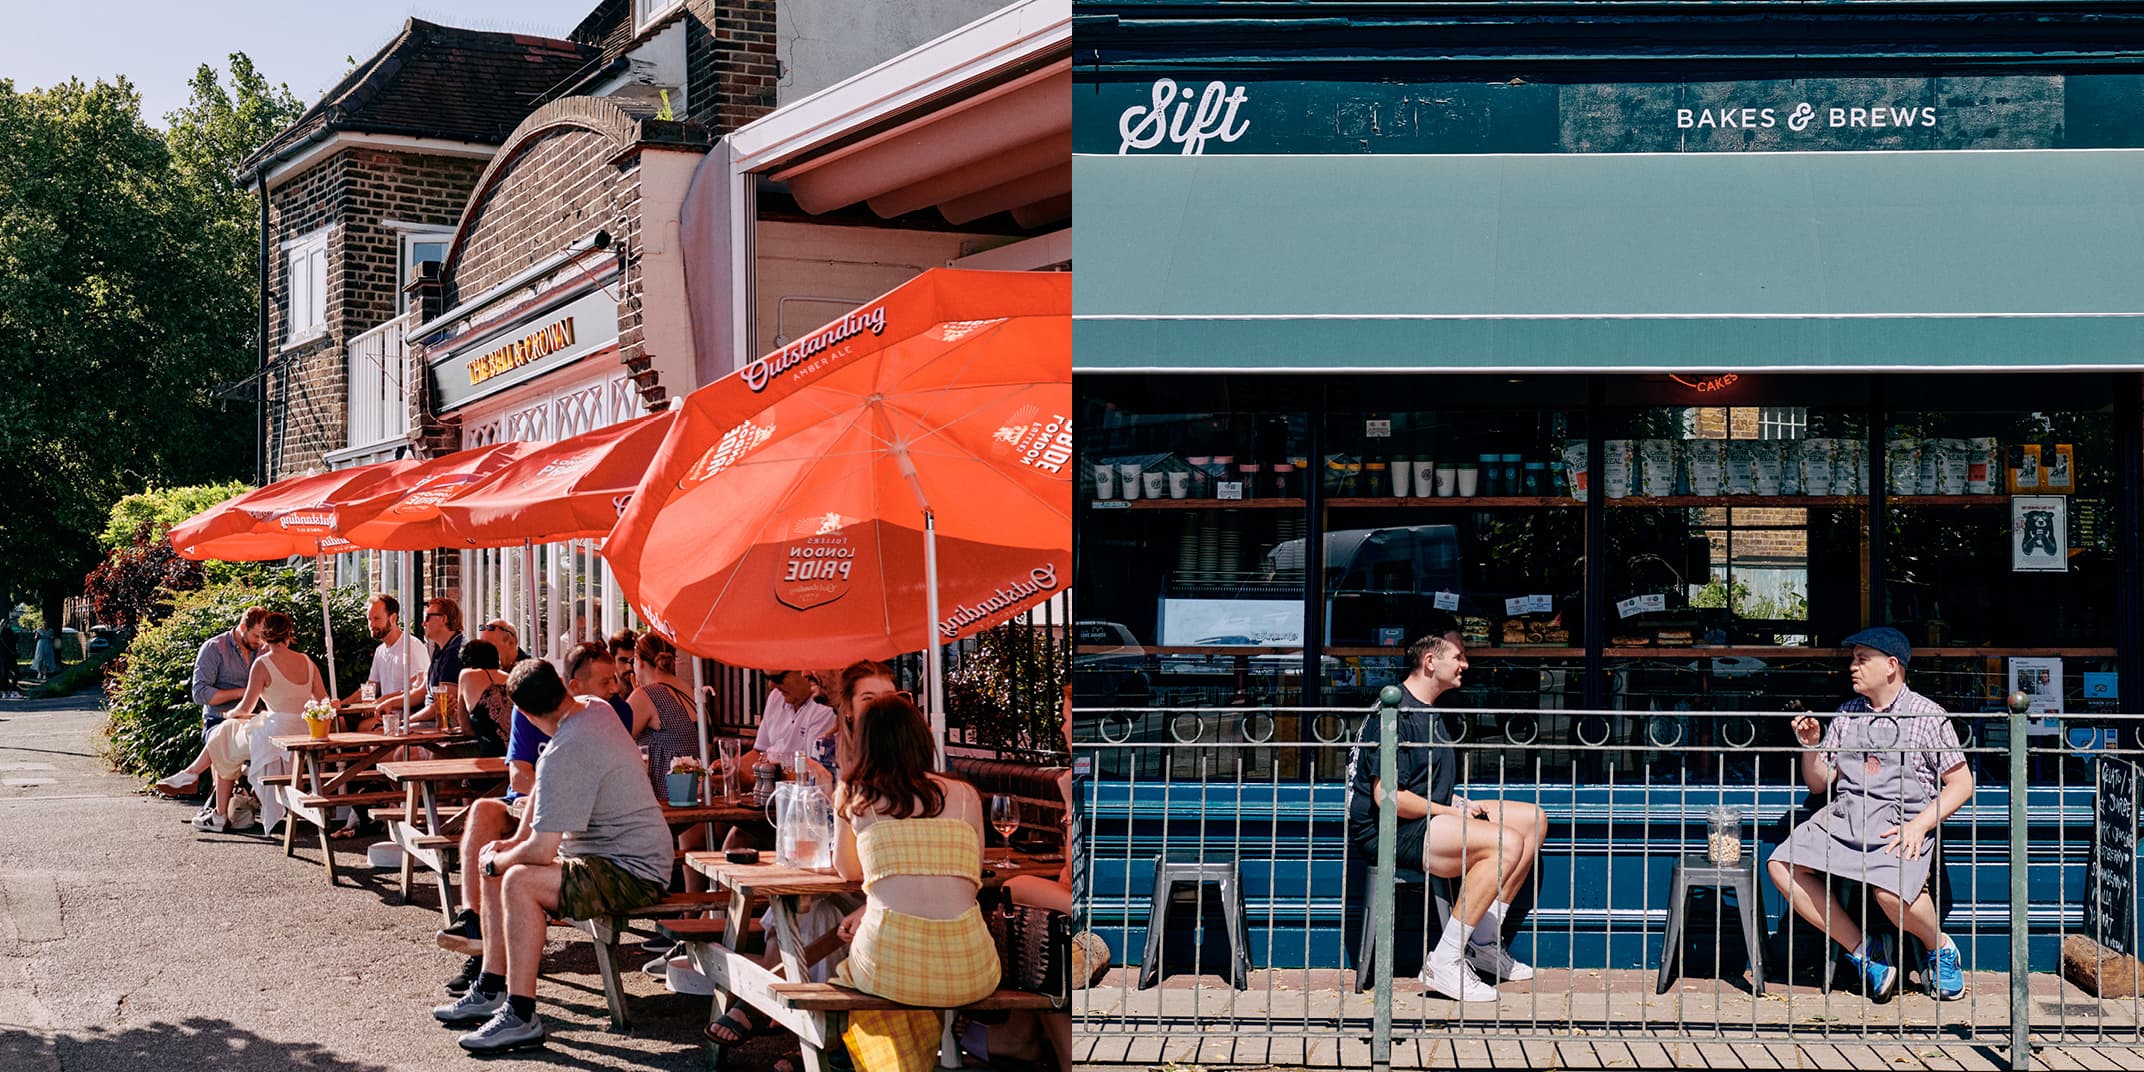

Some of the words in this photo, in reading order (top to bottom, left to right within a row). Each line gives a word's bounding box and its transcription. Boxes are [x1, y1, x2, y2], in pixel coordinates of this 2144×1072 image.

[1118, 78, 1250, 155] Sift
[1676, 108, 1776, 129] BAKES
[1787, 102, 1815, 131] &
[1829, 107, 1937, 128] BREWS
[466, 354, 490, 385] THE
[514, 339, 529, 368] &
[525, 316, 576, 361] CROWN
[740, 304, 887, 393] Outstanding
[792, 357, 829, 382] AMBER
[831, 345, 854, 363] ALE
[1697, 372, 1738, 393] CAKES
